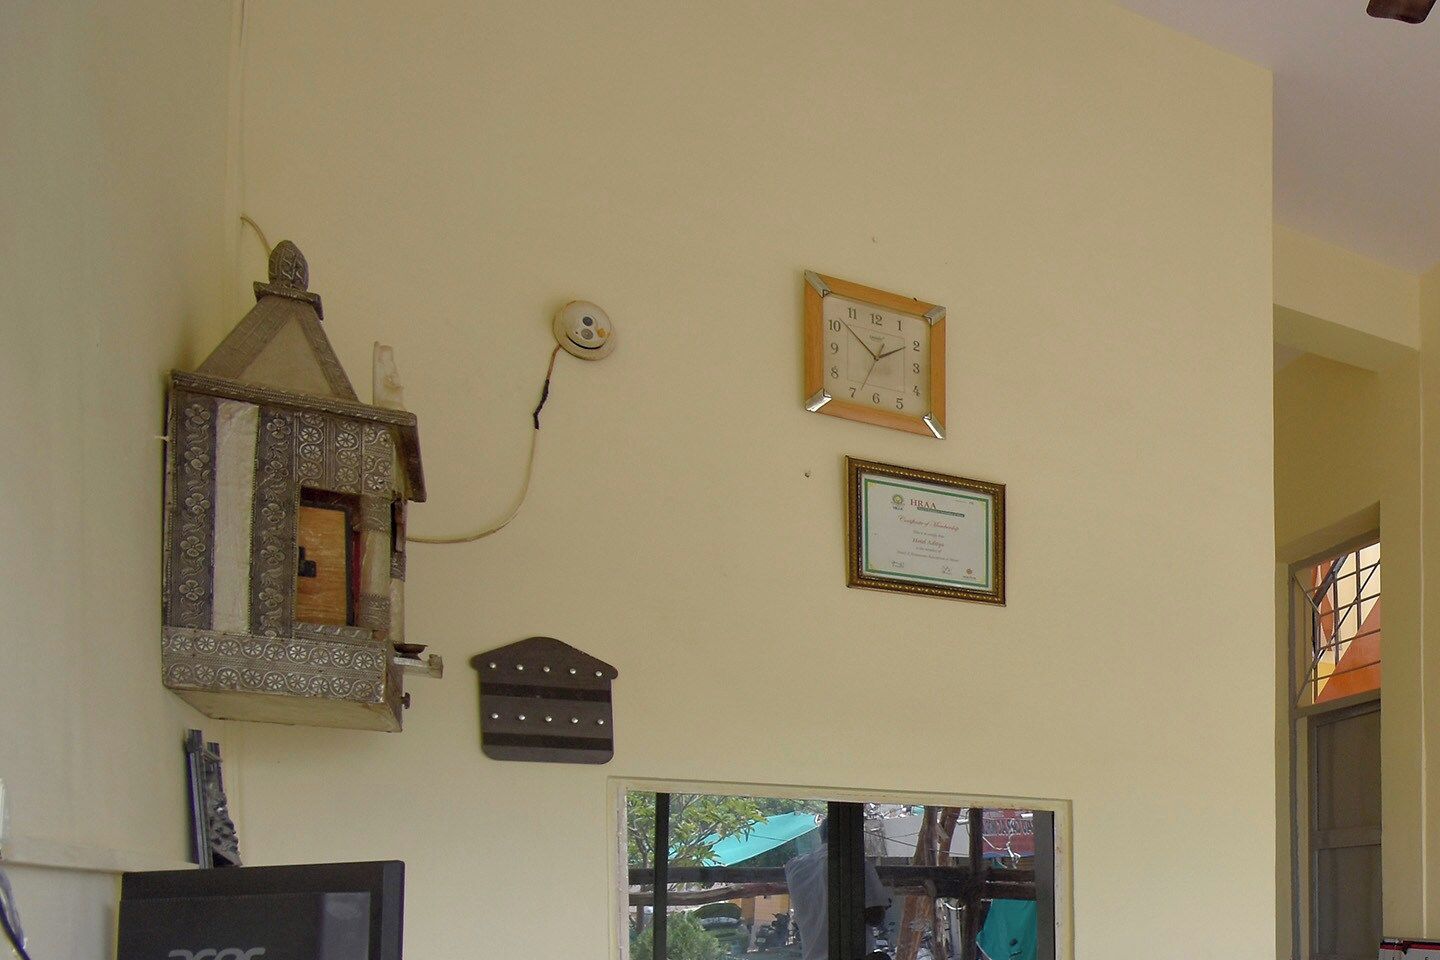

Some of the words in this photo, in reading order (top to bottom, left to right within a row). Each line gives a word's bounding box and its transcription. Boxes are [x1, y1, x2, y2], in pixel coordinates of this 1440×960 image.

[848, 307, 857, 320] 11
[870, 313, 883, 326] 12
[828, 319, 841, 332] 10
[830, 343, 839, 355] 9
[912, 340, 920, 352] 2
[830, 366, 839, 379] 8
[912, 363, 920, 375] 3
[848, 387, 856, 398] 7
[913, 385, 920, 397] 4
[872, 393, 880, 404] 6
[896, 398, 904, 410] 5
